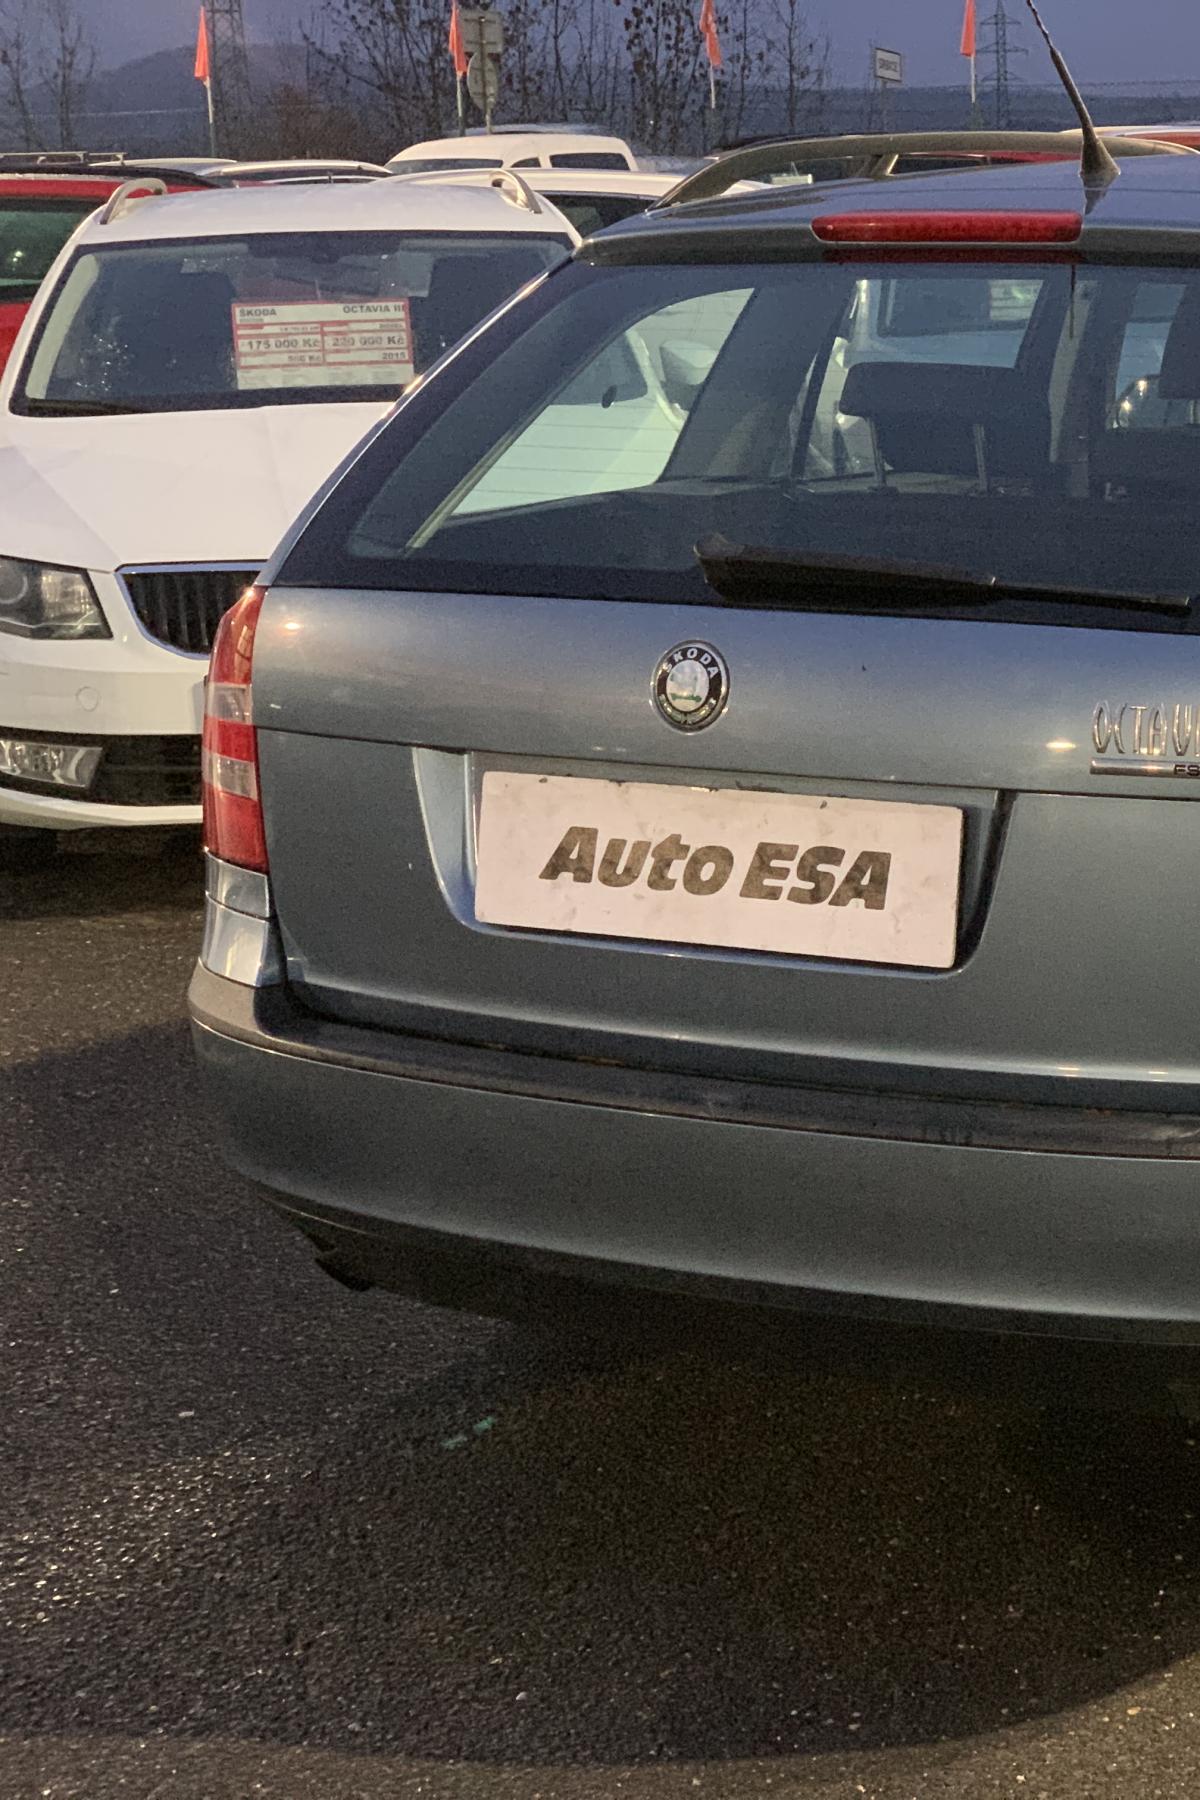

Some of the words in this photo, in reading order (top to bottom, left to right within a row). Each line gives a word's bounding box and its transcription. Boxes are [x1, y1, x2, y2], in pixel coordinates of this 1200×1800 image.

[343, 304, 391, 314] OCTAVIA
[247, 338, 271, 350] 175
[274, 338, 298, 349] 000
[538, 825, 735, 897] Auto
[738, 841, 892, 911] ESA
